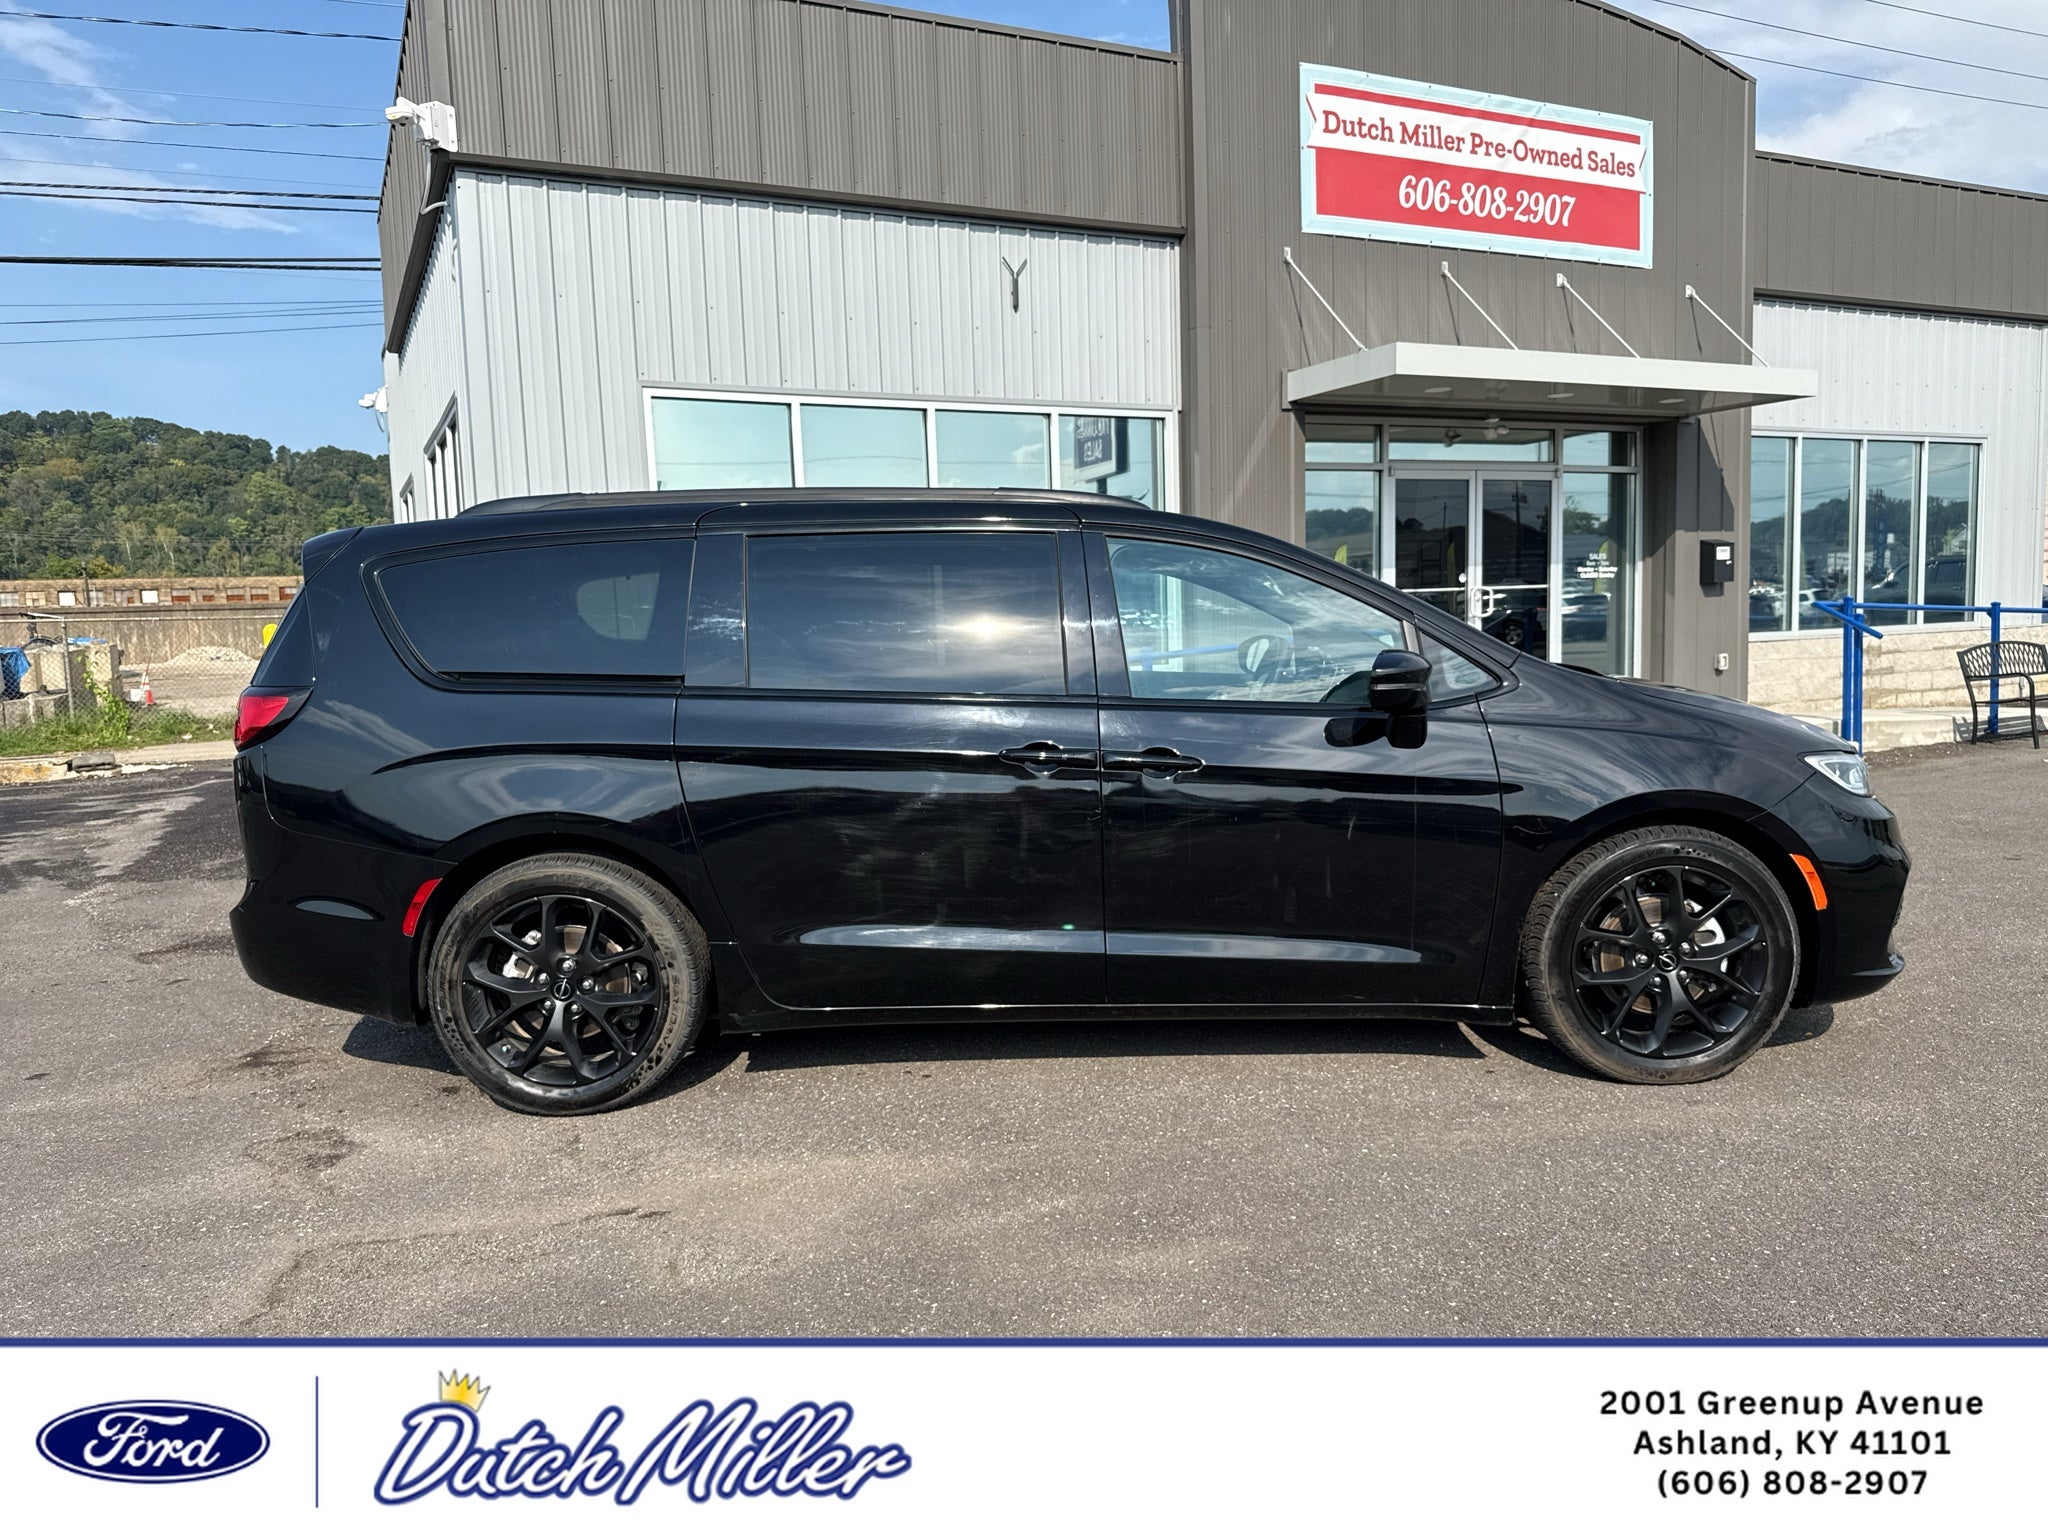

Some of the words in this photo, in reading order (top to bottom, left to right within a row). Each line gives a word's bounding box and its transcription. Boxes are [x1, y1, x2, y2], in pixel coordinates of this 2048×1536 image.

[1323, 109, 1395, 143] Dutch
[1400, 121, 1466, 153] Miller
[1470, 132, 1584, 170] Pre-Owned
[1588, 150, 1636, 178] Sales
[1398, 174, 1577, 228] 606-808-2907
